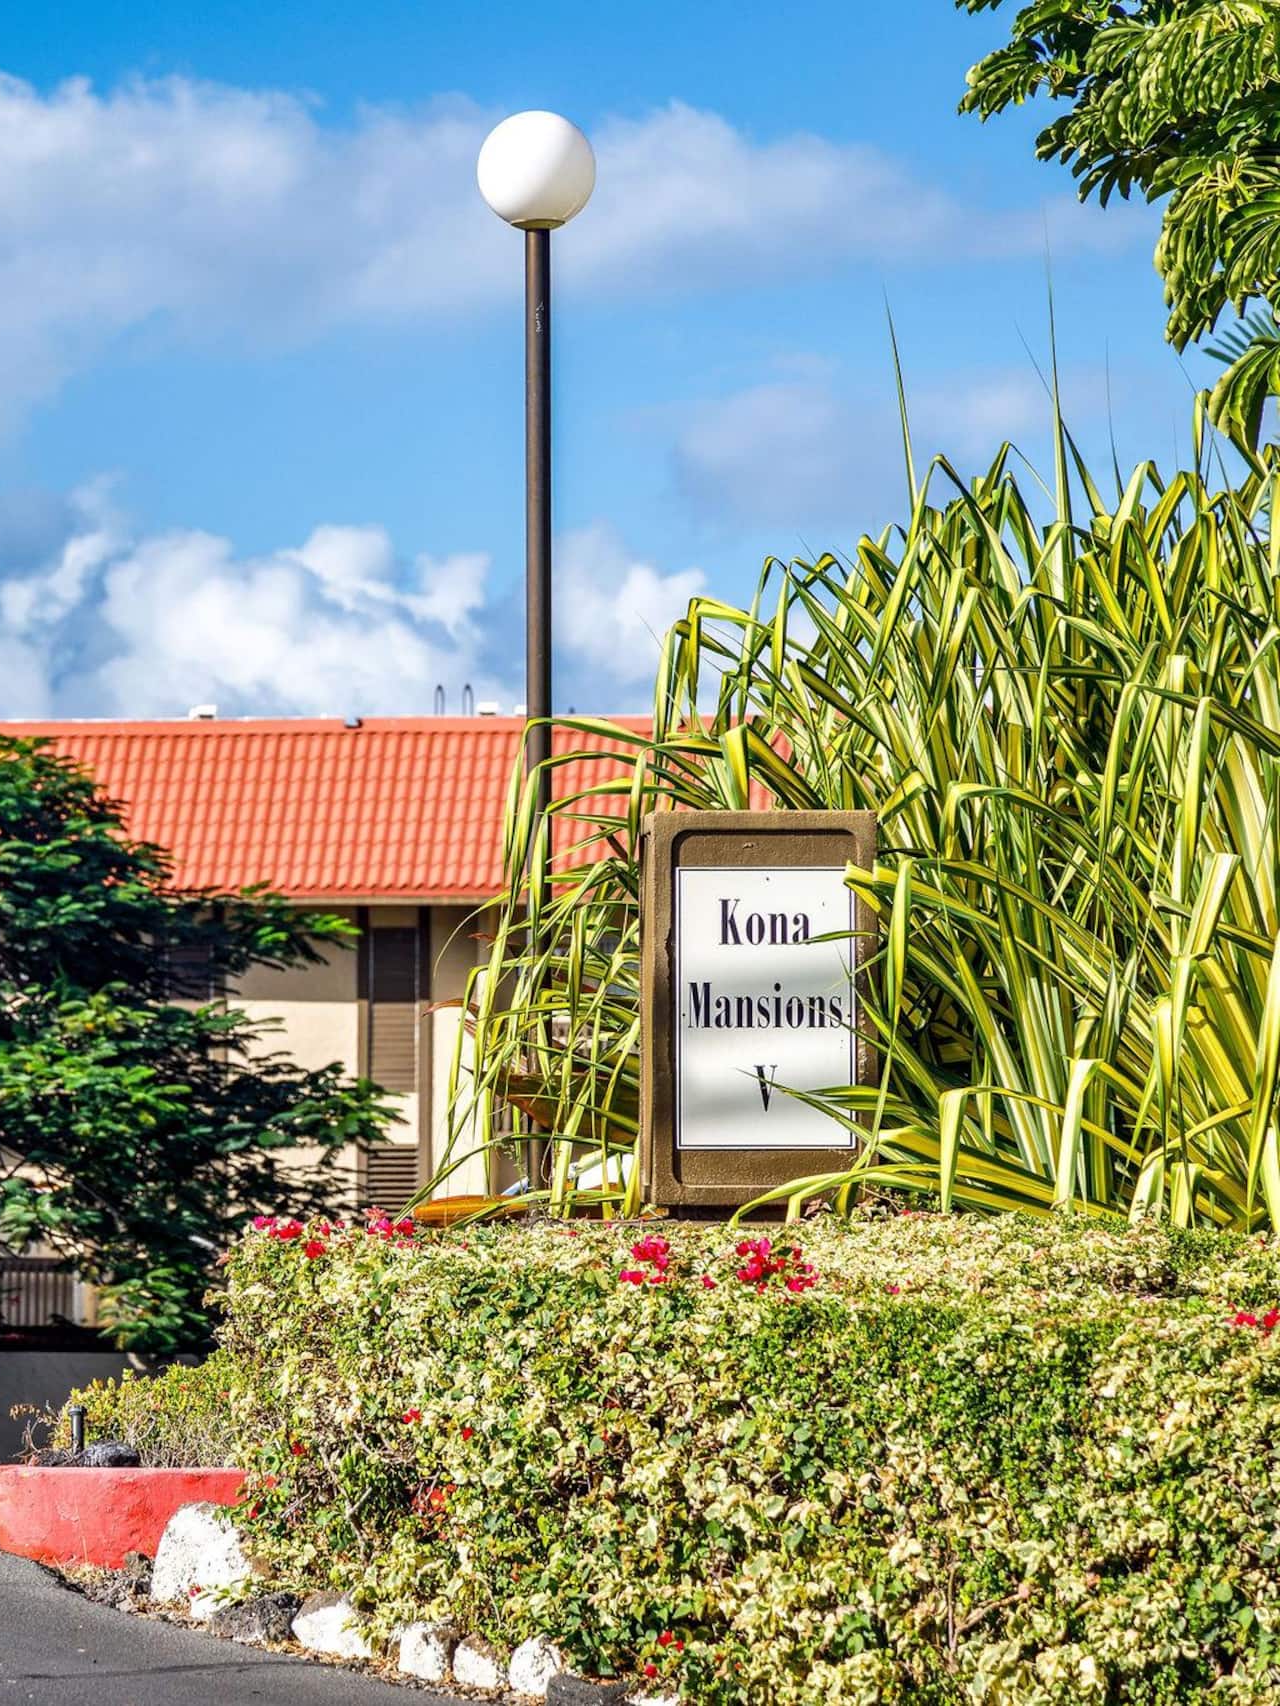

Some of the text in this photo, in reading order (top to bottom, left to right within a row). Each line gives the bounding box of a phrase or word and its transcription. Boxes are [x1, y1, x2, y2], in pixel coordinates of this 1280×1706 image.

[718, 898, 811, 945] Kona
[687, 982, 843, 1028] Mansions
[754, 1065, 778, 1112] V
